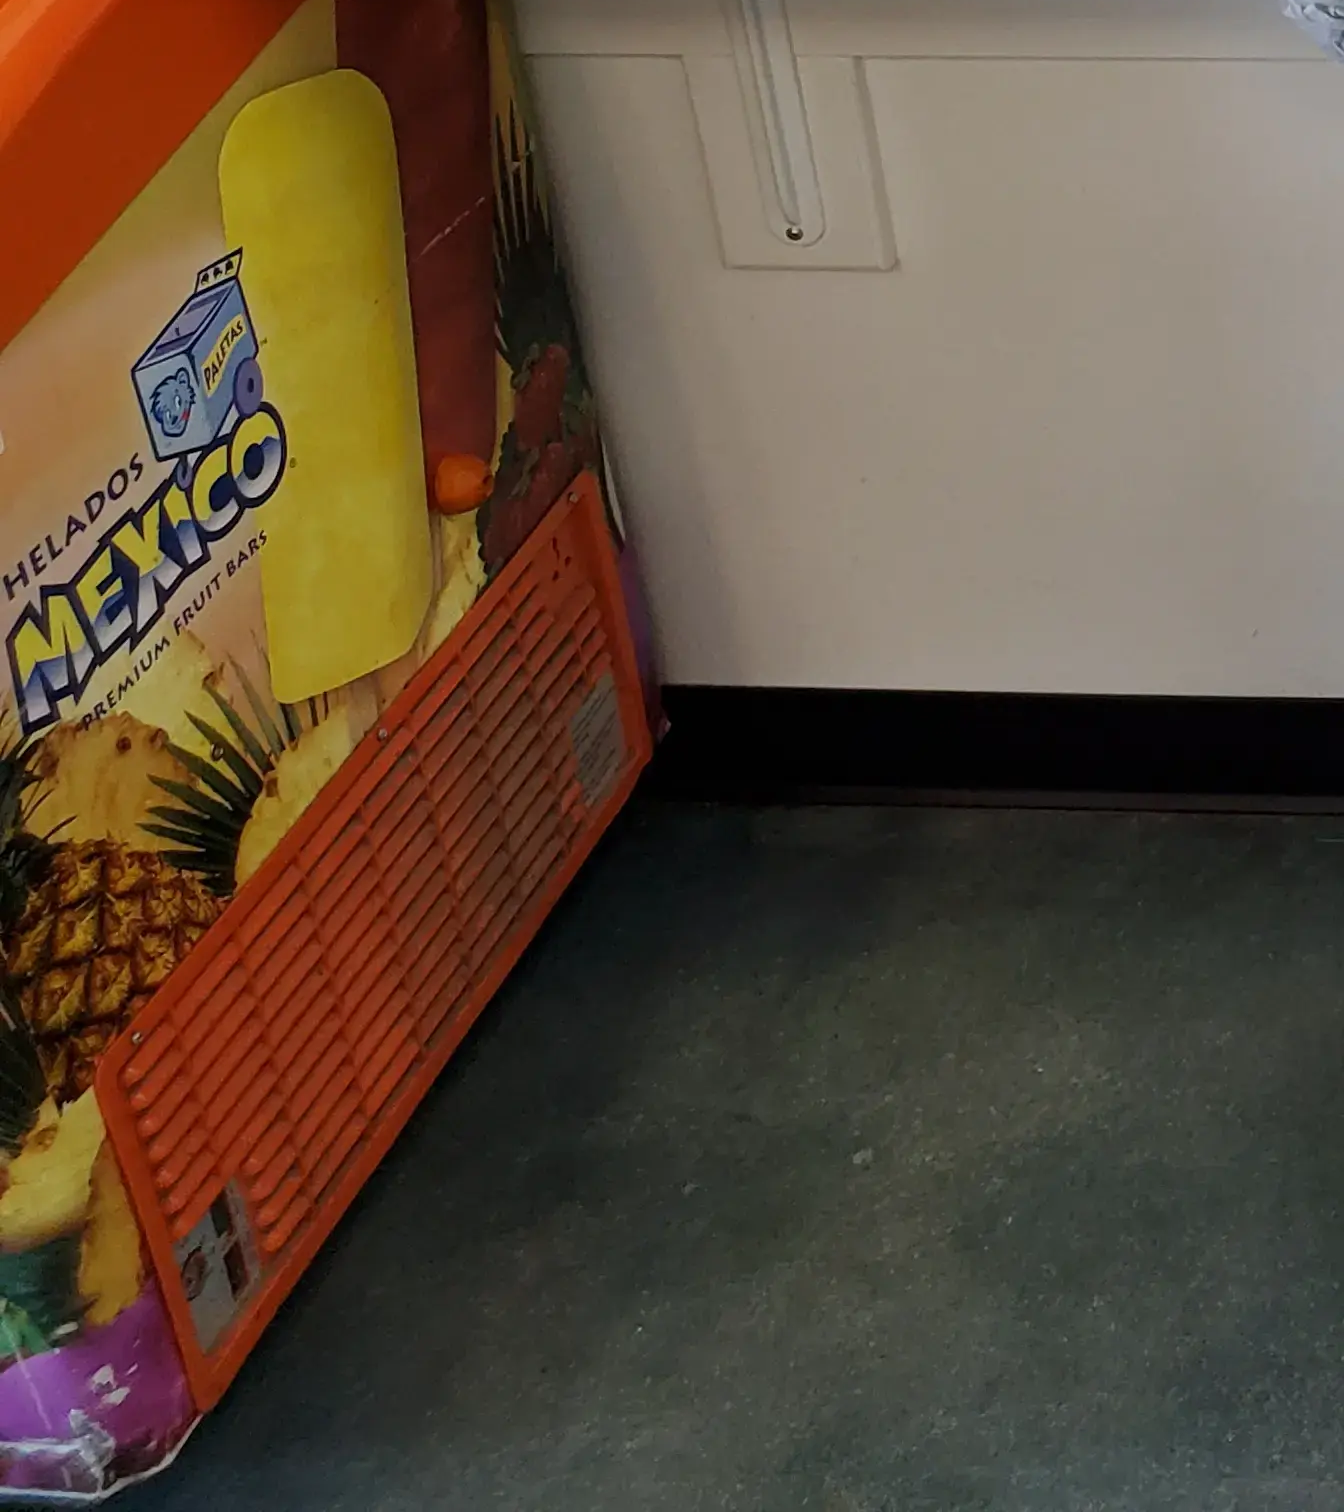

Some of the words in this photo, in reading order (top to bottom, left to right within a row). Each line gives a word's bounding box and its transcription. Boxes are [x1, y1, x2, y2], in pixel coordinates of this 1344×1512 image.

[203, 319, 245, 392] PALETAS
[3, 450, 145, 604] HELADOS
[6, 400, 288, 736] MEXICO
[80, 635, 171, 734] PREMIUM
[173, 577, 222, 636] FRUIT
[226, 528, 269, 582] BARS
